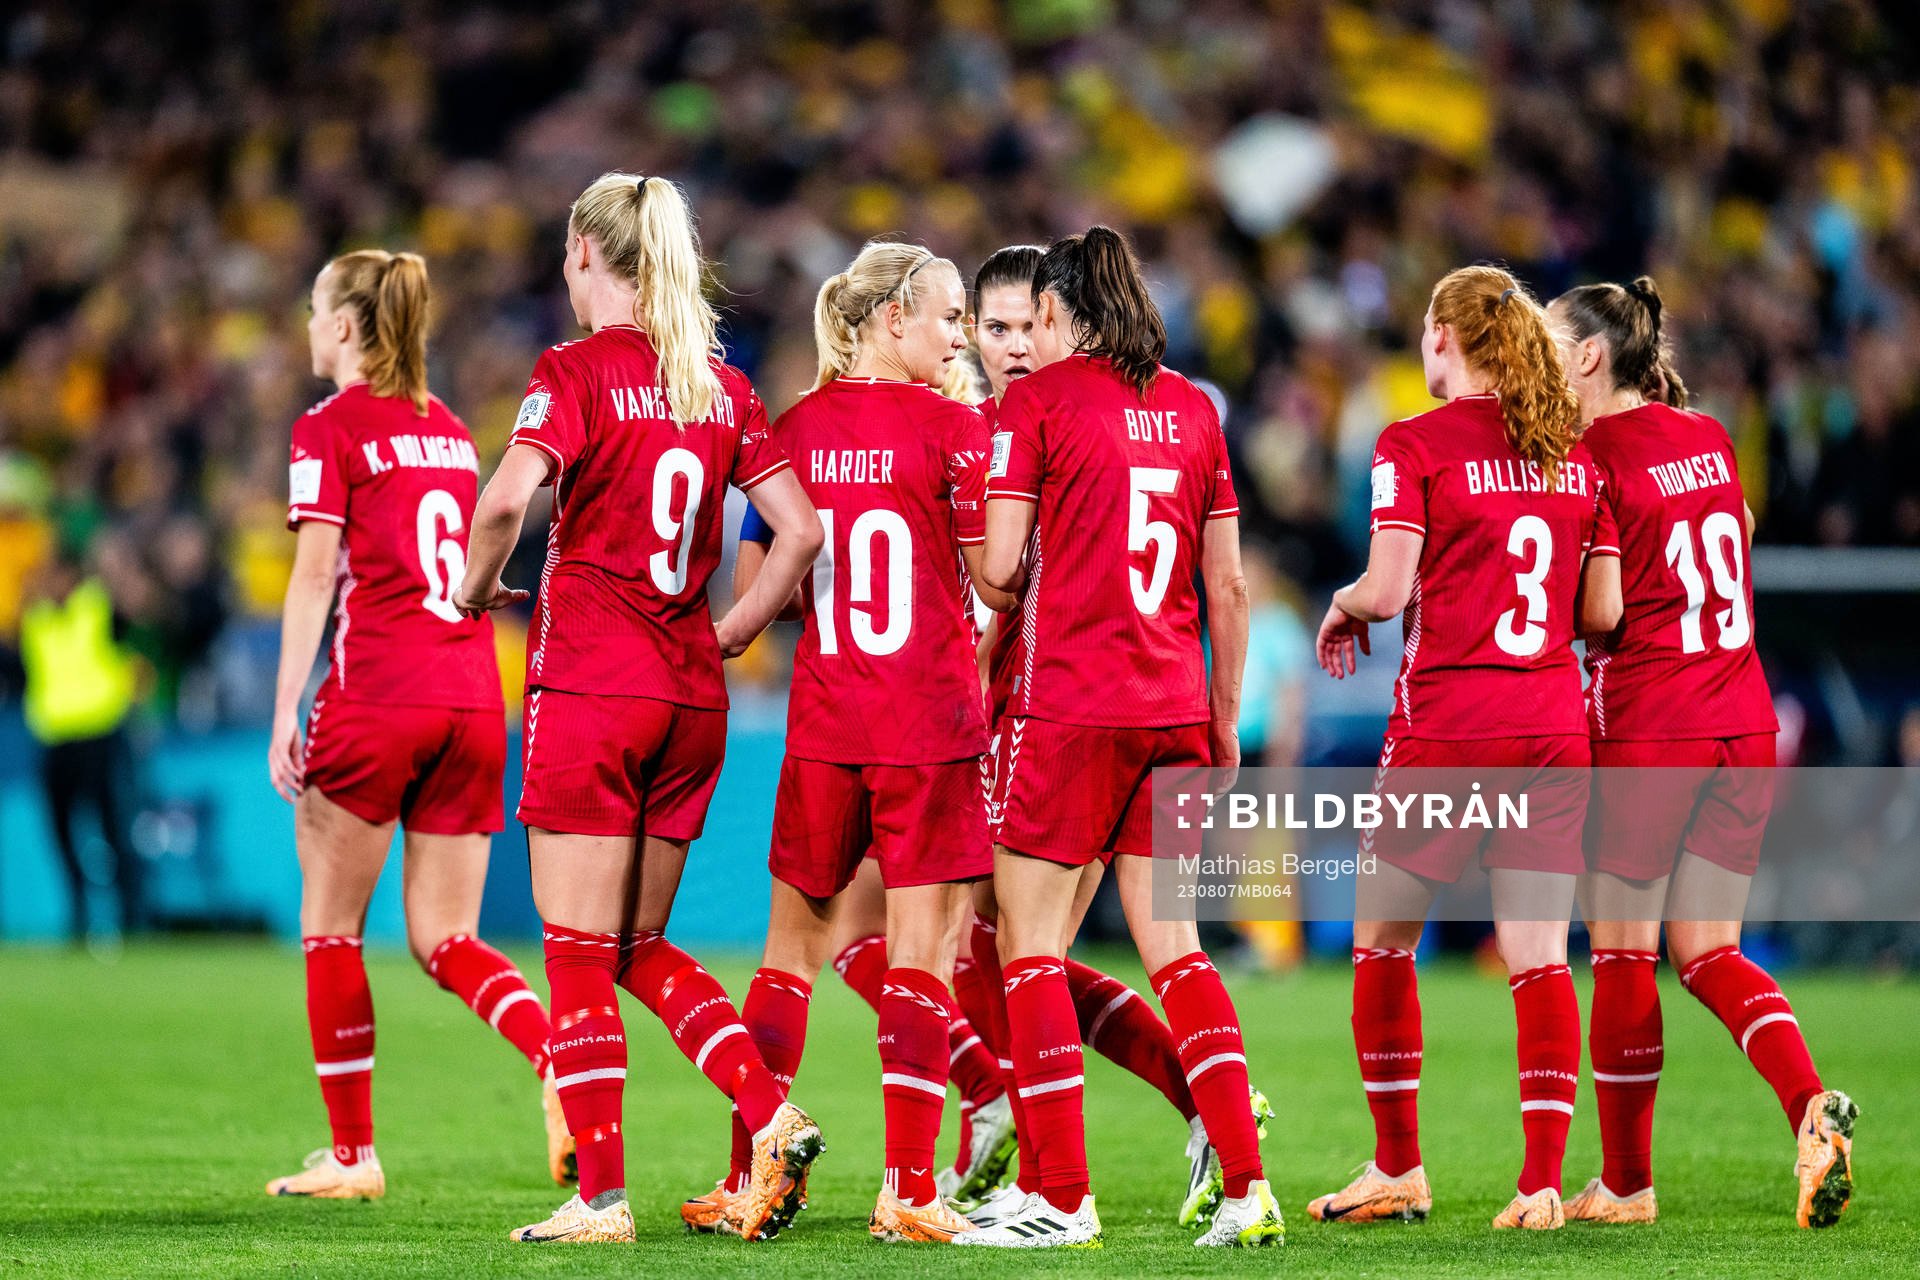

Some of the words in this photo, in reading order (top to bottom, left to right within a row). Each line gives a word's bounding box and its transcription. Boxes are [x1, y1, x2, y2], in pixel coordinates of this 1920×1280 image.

[362, 439, 393, 475] K.
[812, 450, 893, 483] HARDER
[1125, 409, 1180, 443] BOYE
[1648, 452, 1730, 496] THOMSEN
[416, 489, 467, 623] 6
[650, 448, 704, 595] 9
[1128, 467, 1179, 615] 5
[812, 508, 914, 656] 10
[1495, 516, 1552, 656] 3
[1665, 511, 1751, 654] 19
[552, 1033, 623, 1053] DENMARK
[1178, 1026, 1239, 1055] DENMARK
